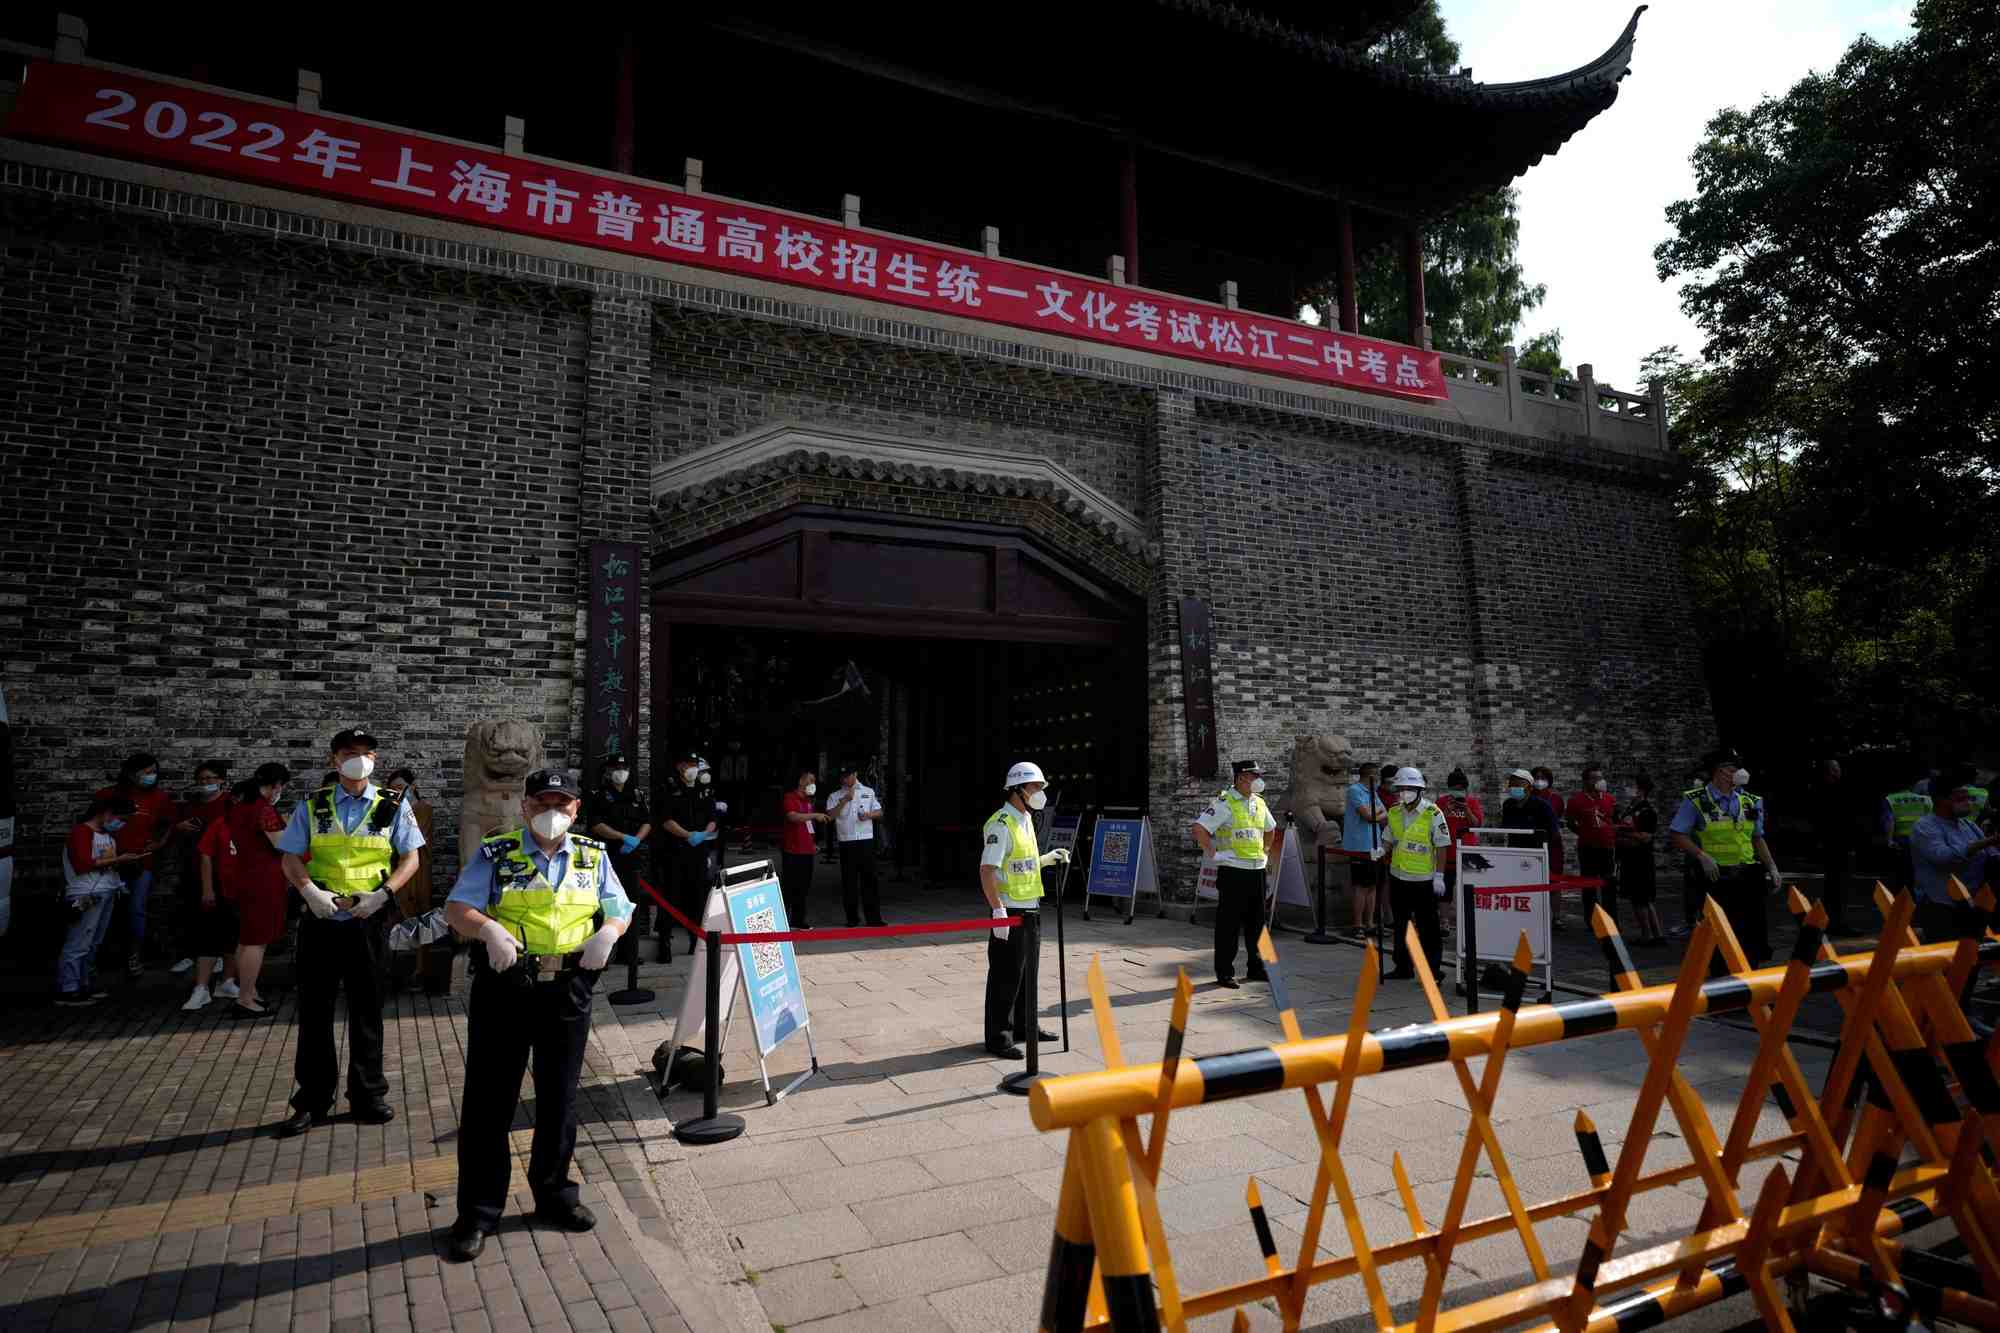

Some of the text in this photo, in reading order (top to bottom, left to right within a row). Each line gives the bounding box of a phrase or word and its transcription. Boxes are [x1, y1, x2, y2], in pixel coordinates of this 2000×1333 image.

[84, 88, 1426, 389] 2022年上海市普通高校招生统一文化考试松江二中考点
[1185, 627, 1210, 749] 松江二中
[1474, 894, 1532, 912] 缓冲区
